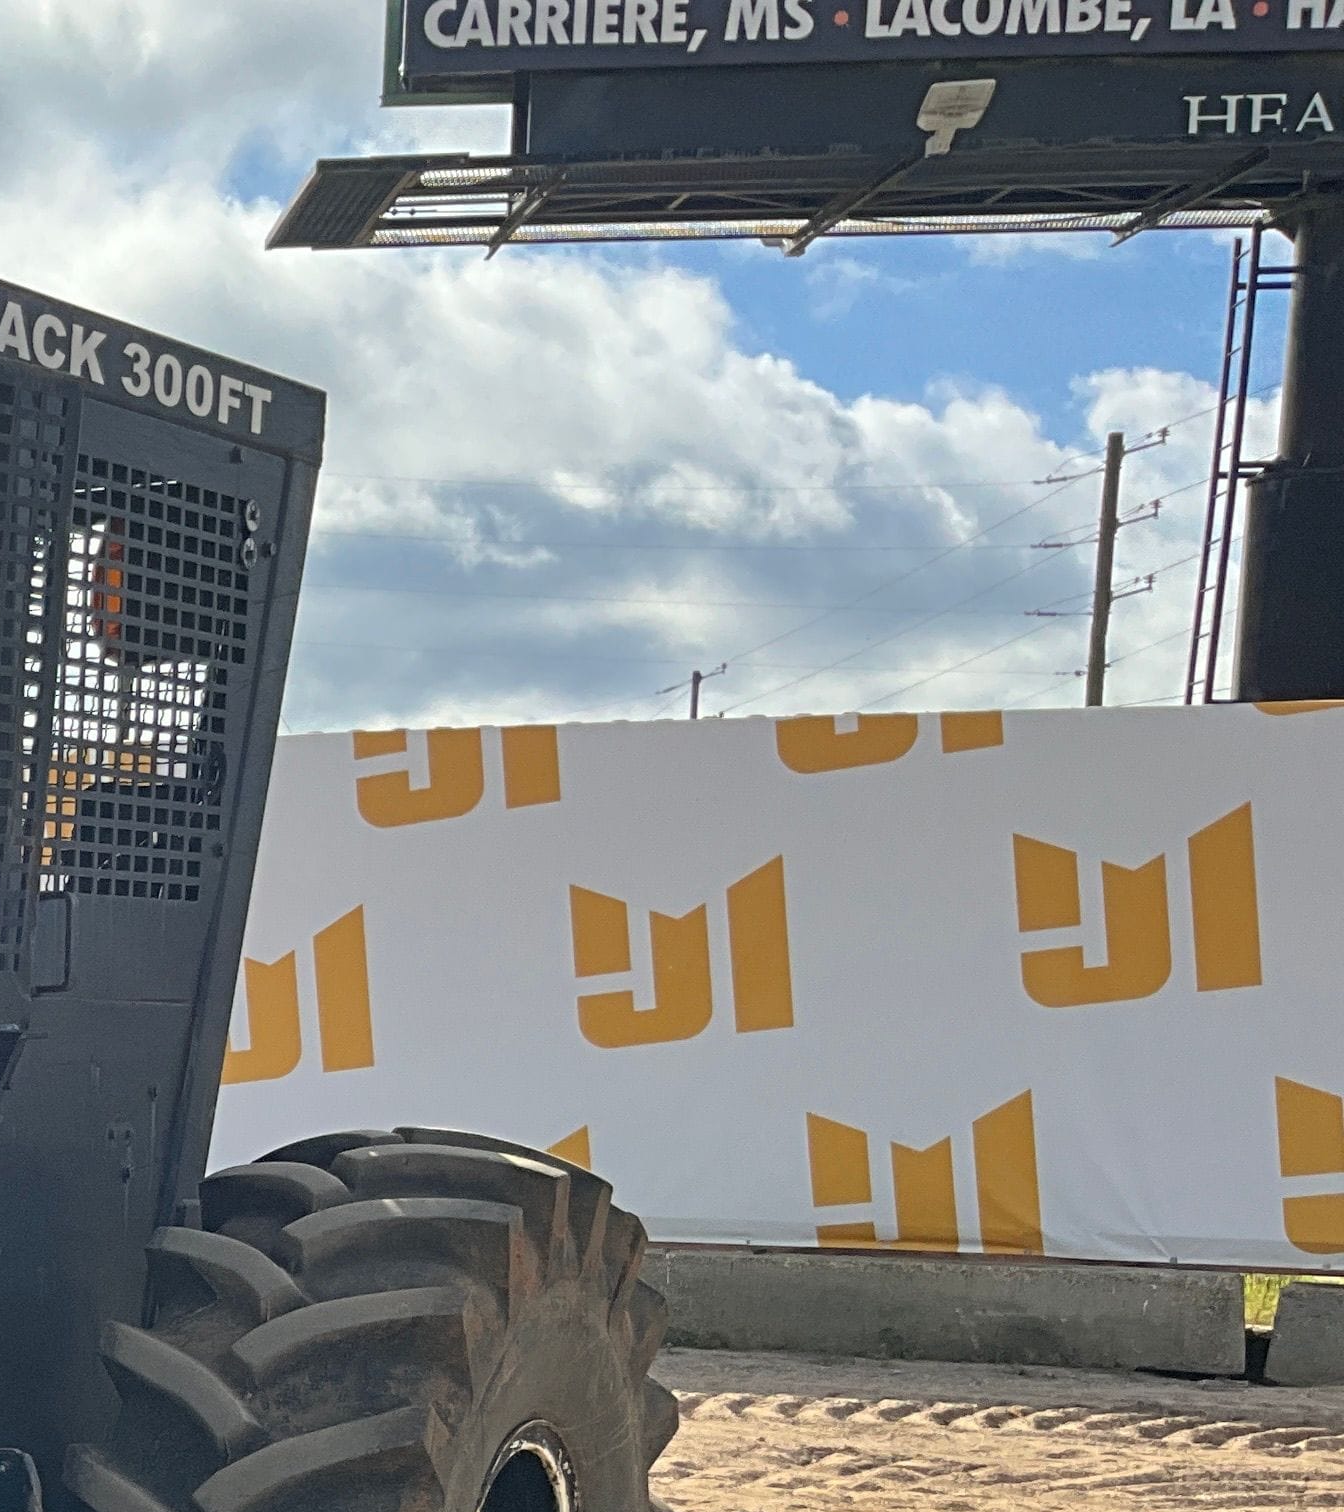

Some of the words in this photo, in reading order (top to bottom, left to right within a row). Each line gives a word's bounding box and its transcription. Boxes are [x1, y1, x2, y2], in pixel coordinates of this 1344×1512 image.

[424, 0, 709, 52] CARRIERE,
[724, 0, 814, 41] MS
[865, 0, 1152, 41] LACOMBE,
[1170, 0, 1237, 30] LA
[120, 343, 272, 435] 300FT
